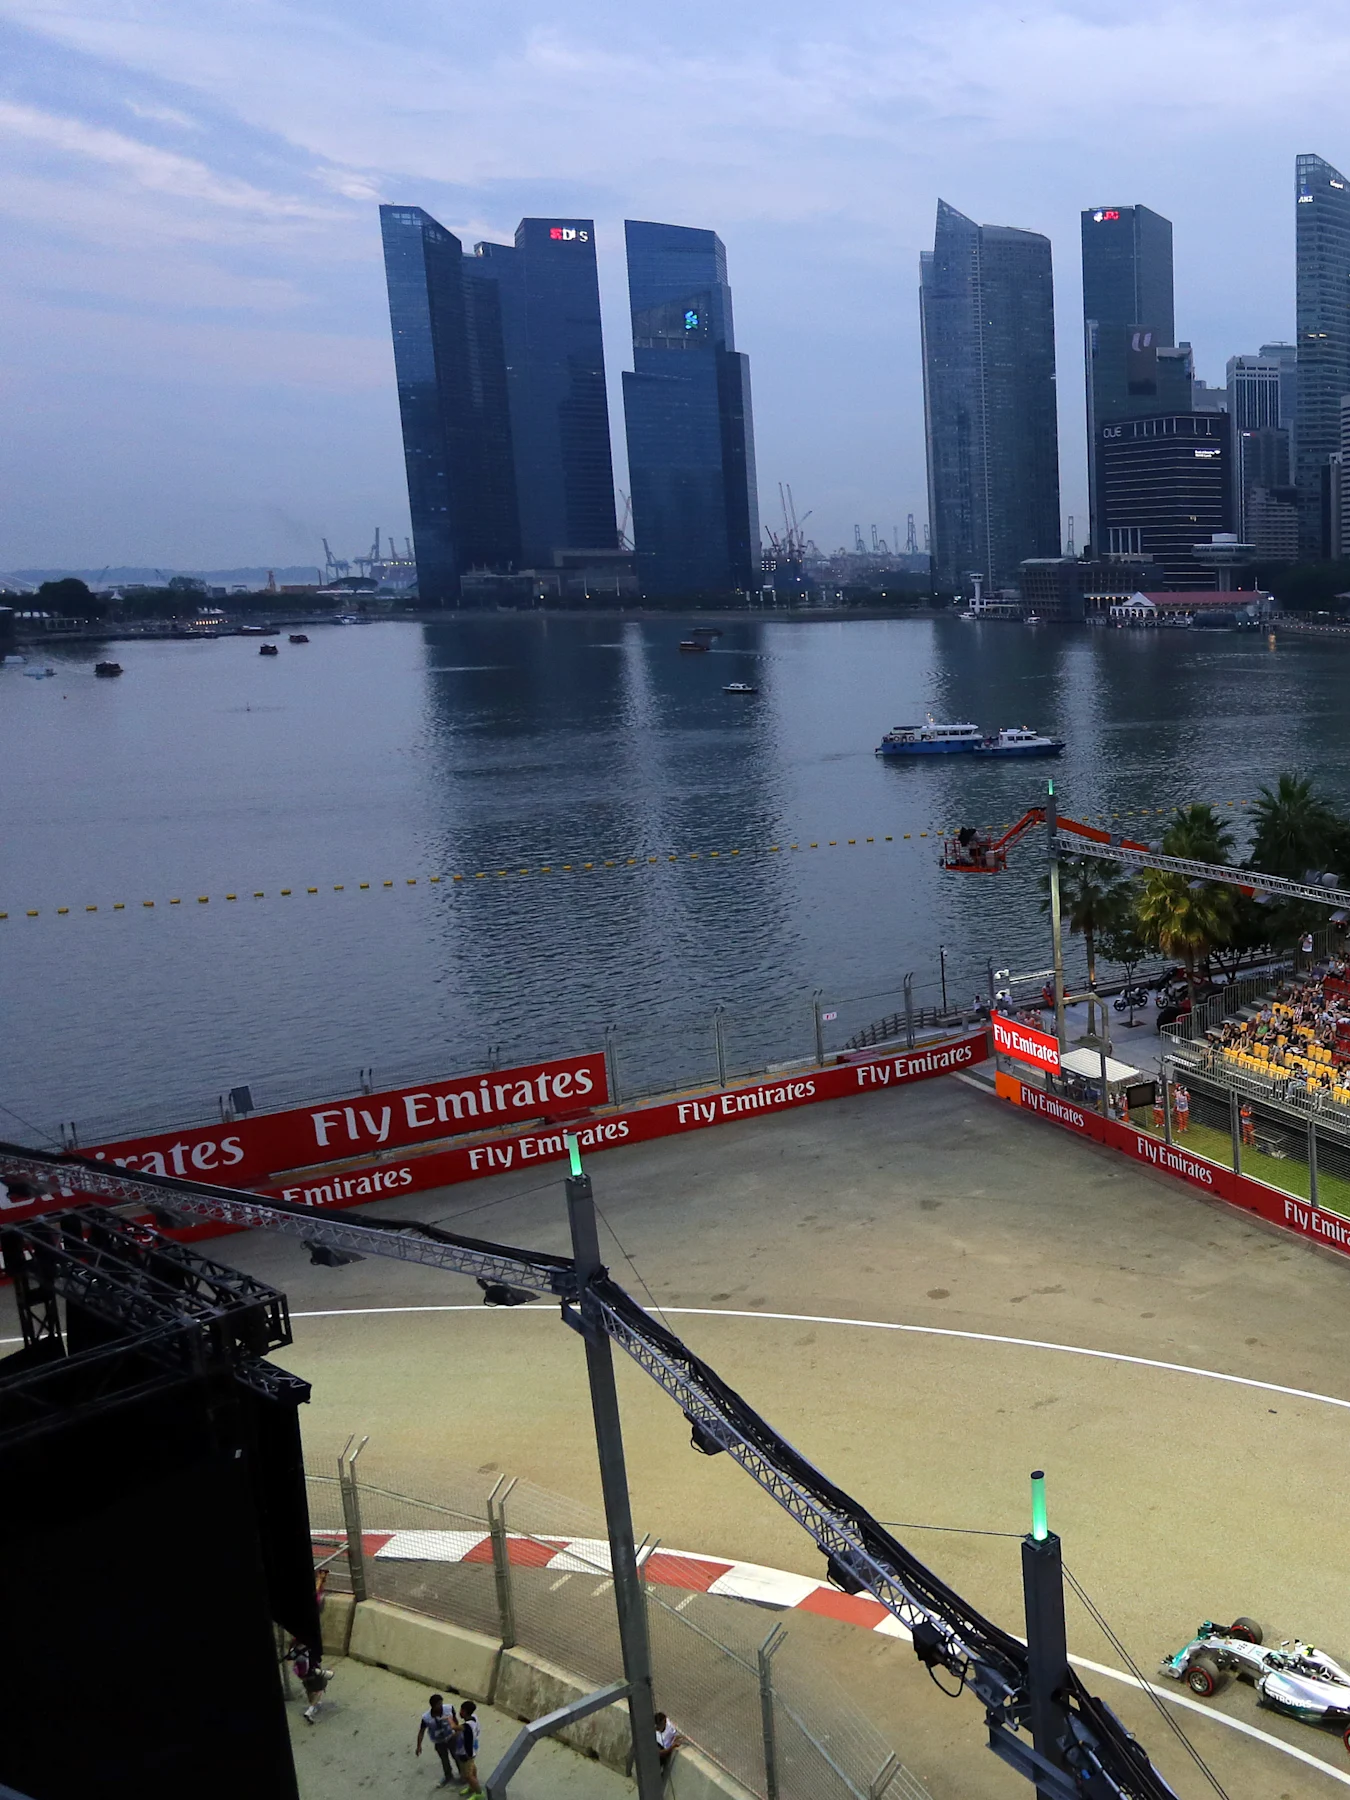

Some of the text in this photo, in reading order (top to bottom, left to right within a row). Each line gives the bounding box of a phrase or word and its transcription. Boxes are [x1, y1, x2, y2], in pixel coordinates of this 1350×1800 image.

[1103, 426, 1122, 439] OUE
[856, 1044, 972, 1087] Fly Emirates
[993, 1023, 1059, 1066] Fly Emirates
[311, 1067, 593, 1147] Fly Emirates
[677, 1080, 816, 1125] Fly Emirates
[1021, 1086, 1085, 1128] Fly Emirates
[469, 1120, 629, 1171] Fly Emirates
[1137, 1136, 1213, 1185] Fly Emirates
[282, 1167, 413, 1206] Emirates
[1284, 1199, 1310, 1231] Fly
